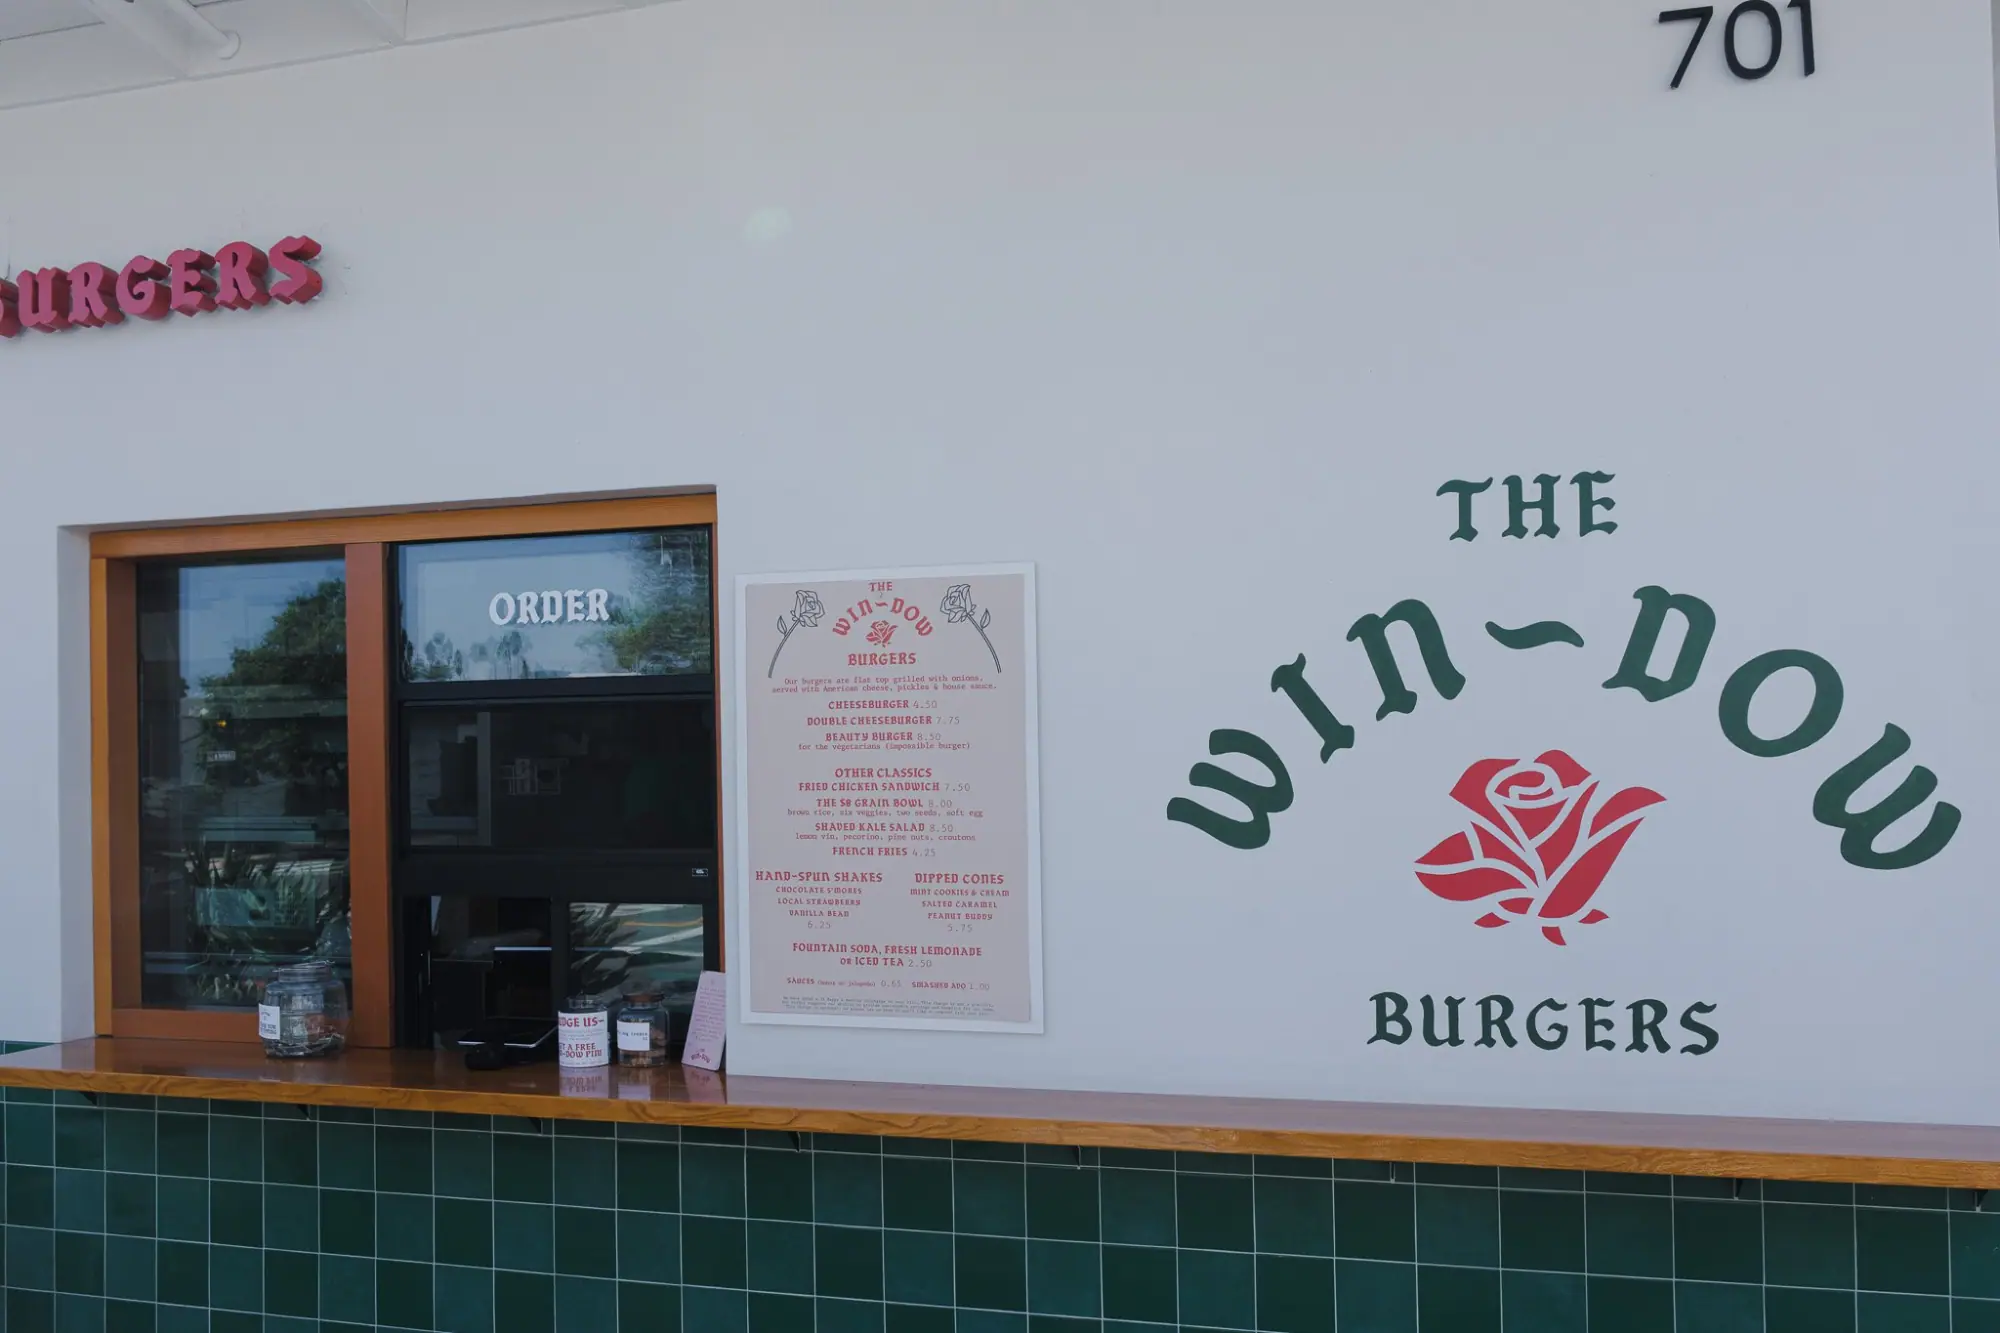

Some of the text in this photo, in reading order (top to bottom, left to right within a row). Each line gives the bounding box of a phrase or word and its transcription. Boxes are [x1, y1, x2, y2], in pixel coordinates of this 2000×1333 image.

[1658, 0, 1815, 90] 701
[0, 235, 322, 338] URGERS
[1436, 471, 1619, 542] THE
[868, 581, 893, 592] THE
[489, 588, 610, 626] ORDER
[848, 653, 916, 665] BURGERS
[802, 678, 832, 687] burgers
[894, 675, 924, 685] grilled
[802, 685, 820, 693] with
[897, 683, 930, 692] pickles
[828, 700, 937, 709] CHEESEBURGER 4.50
[807, 716, 959, 725] DOUBLE CHEESEBURGER 7.75
[825, 732, 941, 741] BEAUTY BURGER 8.50
[835, 768, 932, 778] OTHER CLASSICS
[799, 782, 970, 791] FRIED CHICKEN SANDWICH 7.50
[816, 799, 836, 807] THE
[855, 799, 889, 807] GRAIN
[893, 799, 923, 807] BOWL
[929, 799, 952, 808] 8.00
[947, 808, 964, 816] soft
[859, 823, 886, 831] KALE
[889, 823, 924, 831] SALAD
[929, 824, 953, 832] 8.50
[888, 833, 906, 842] pine
[938, 834, 976, 842] croutons
[832, 847, 935, 857] FRENCH FRIES 4.25
[834, 872, 882, 882] SHAKES
[915, 873, 1004, 884] DIPPED CONES
[808, 920, 832, 929] 6.25
[947, 923, 972, 932] 5.75
[793, 943, 847, 952] FOUNTAIN
[885, 945, 917, 954] FRESH
[921, 946, 981, 956] LEMONADE
[855, 957, 878, 965] ICED
[882, 958, 903, 966] TEA
[908, 959, 932, 968] 2.50
[1366, 991, 1720, 1056] BURGERS
